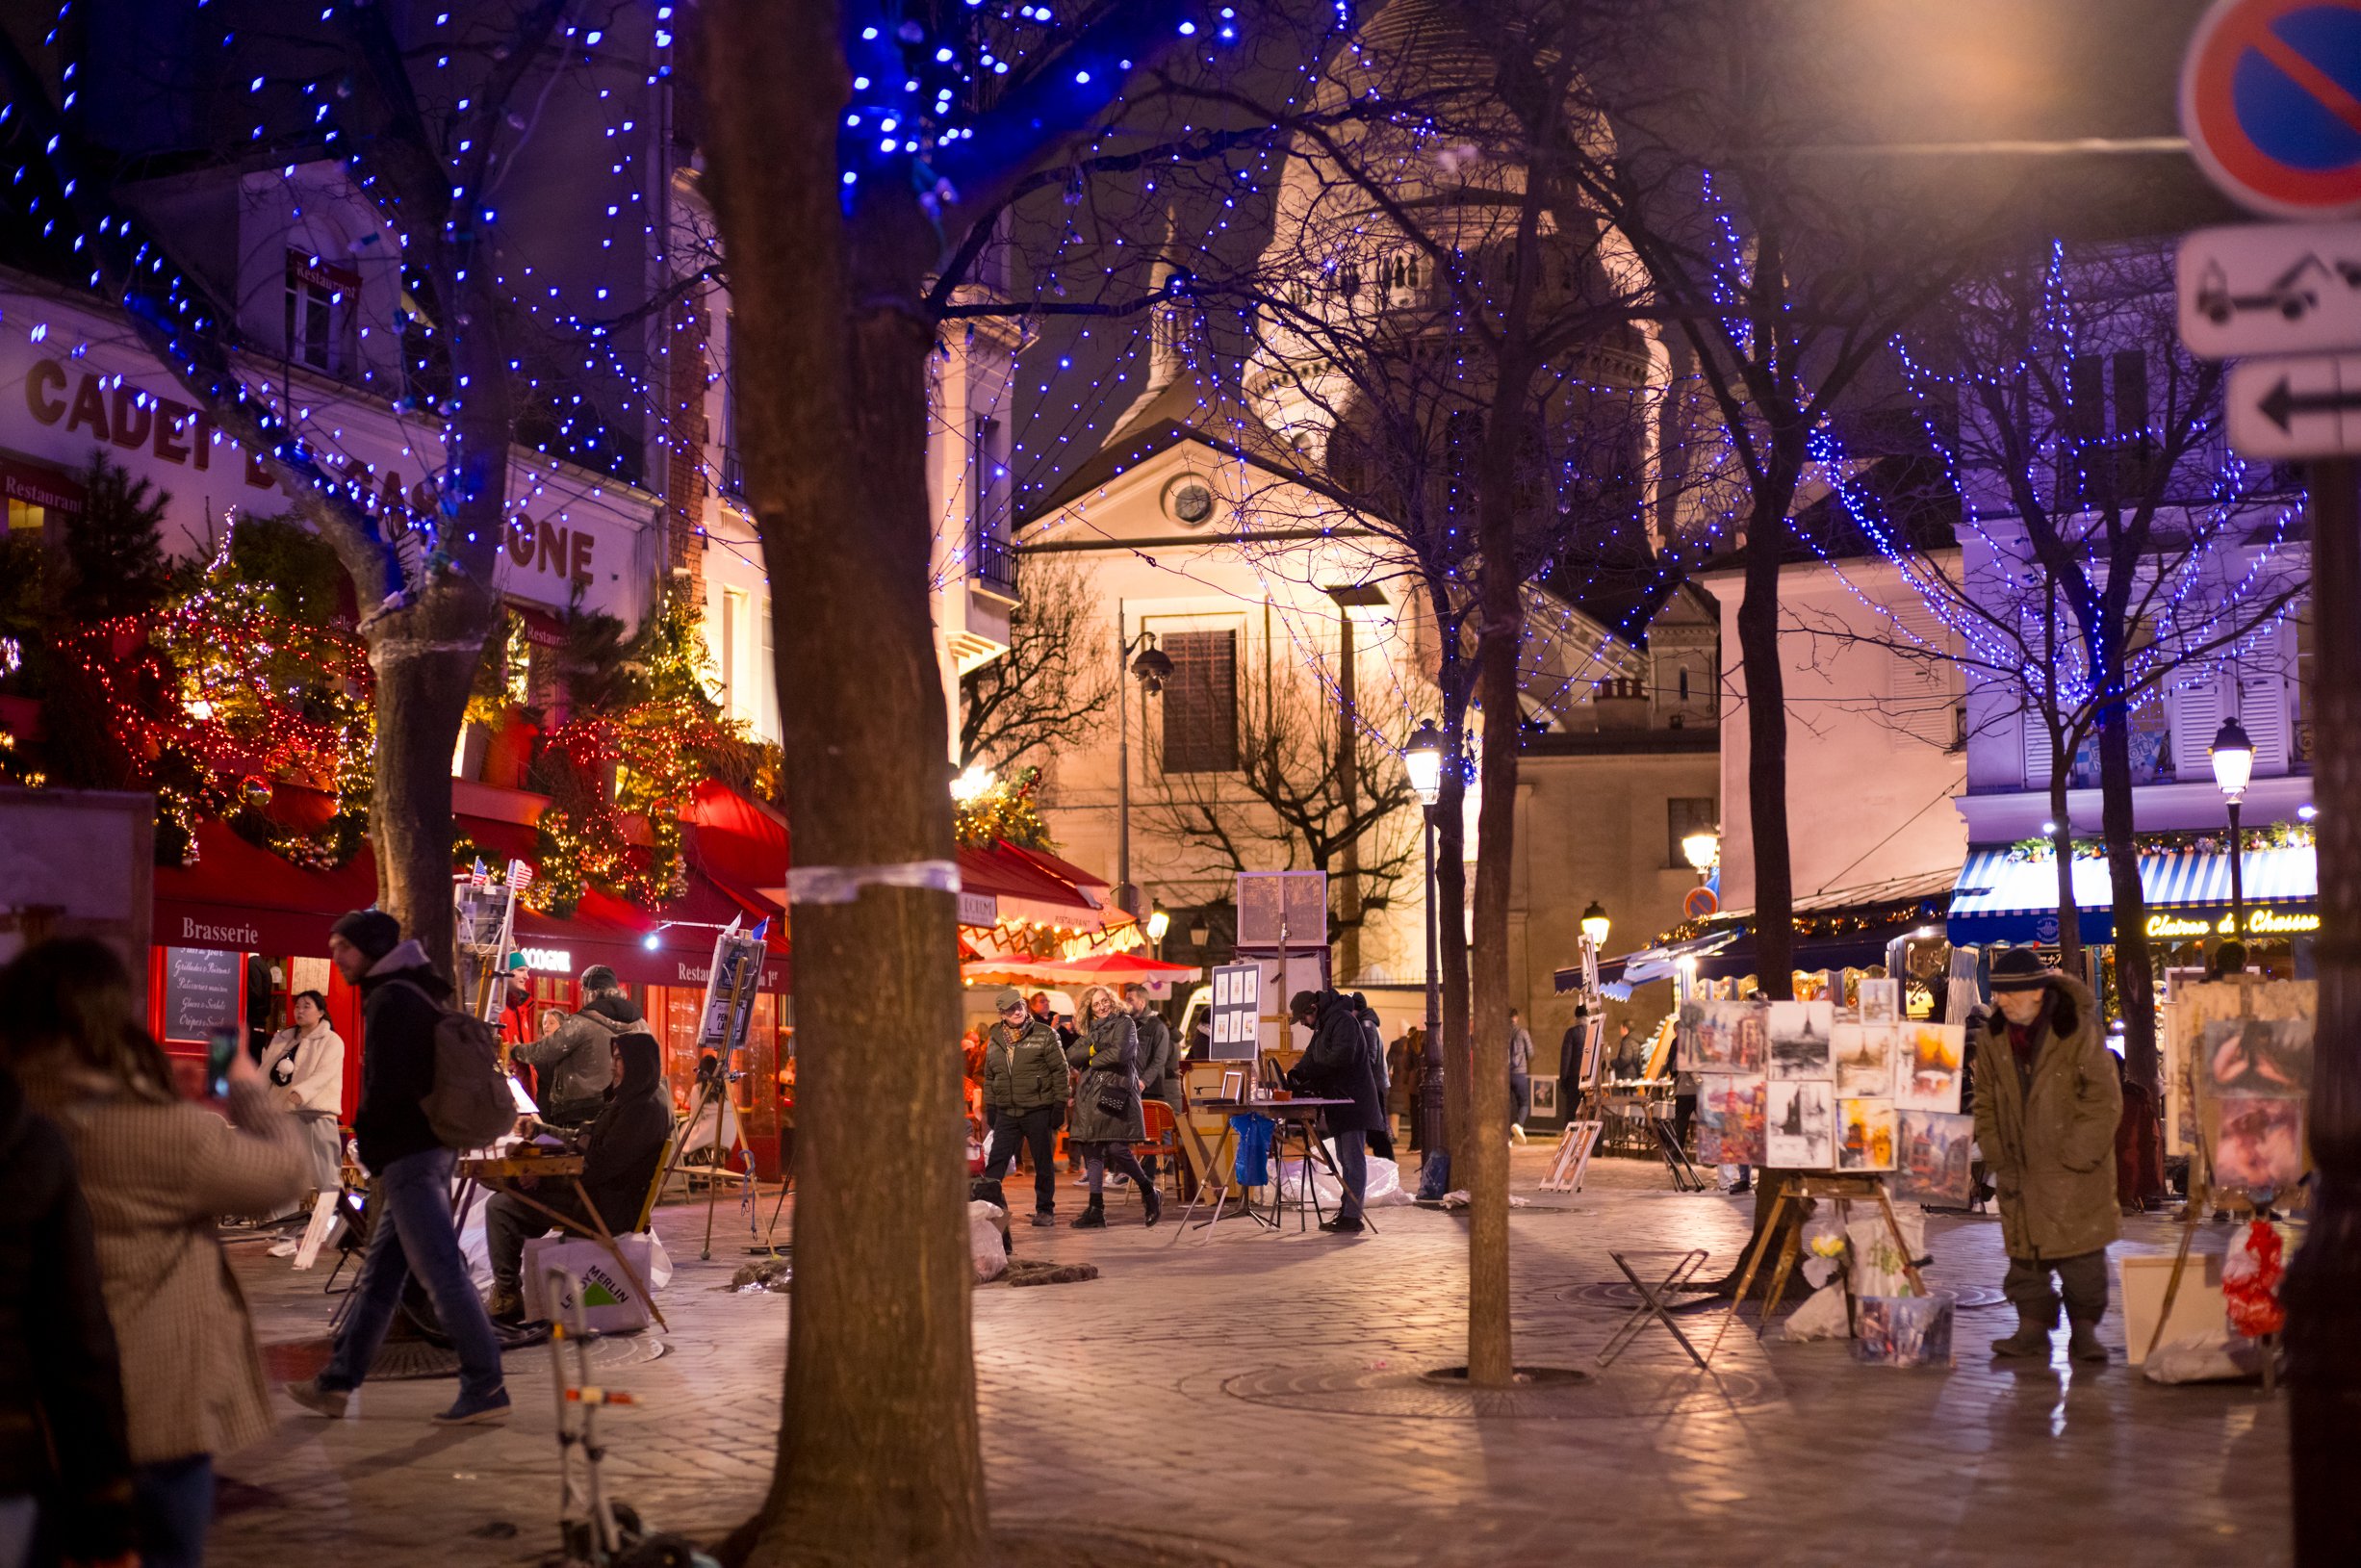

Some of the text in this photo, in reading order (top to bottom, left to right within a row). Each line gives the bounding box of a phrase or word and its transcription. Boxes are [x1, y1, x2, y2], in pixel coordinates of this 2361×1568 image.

[295, 261, 356, 299] Restaurant
[26, 359, 218, 472] CADET
[5, 476, 83, 515] Restaurant
[181, 916, 259, 945] Brasserie
[678, 963, 710, 982] Restau
[588, 1264, 629, 1303] MERLIN
